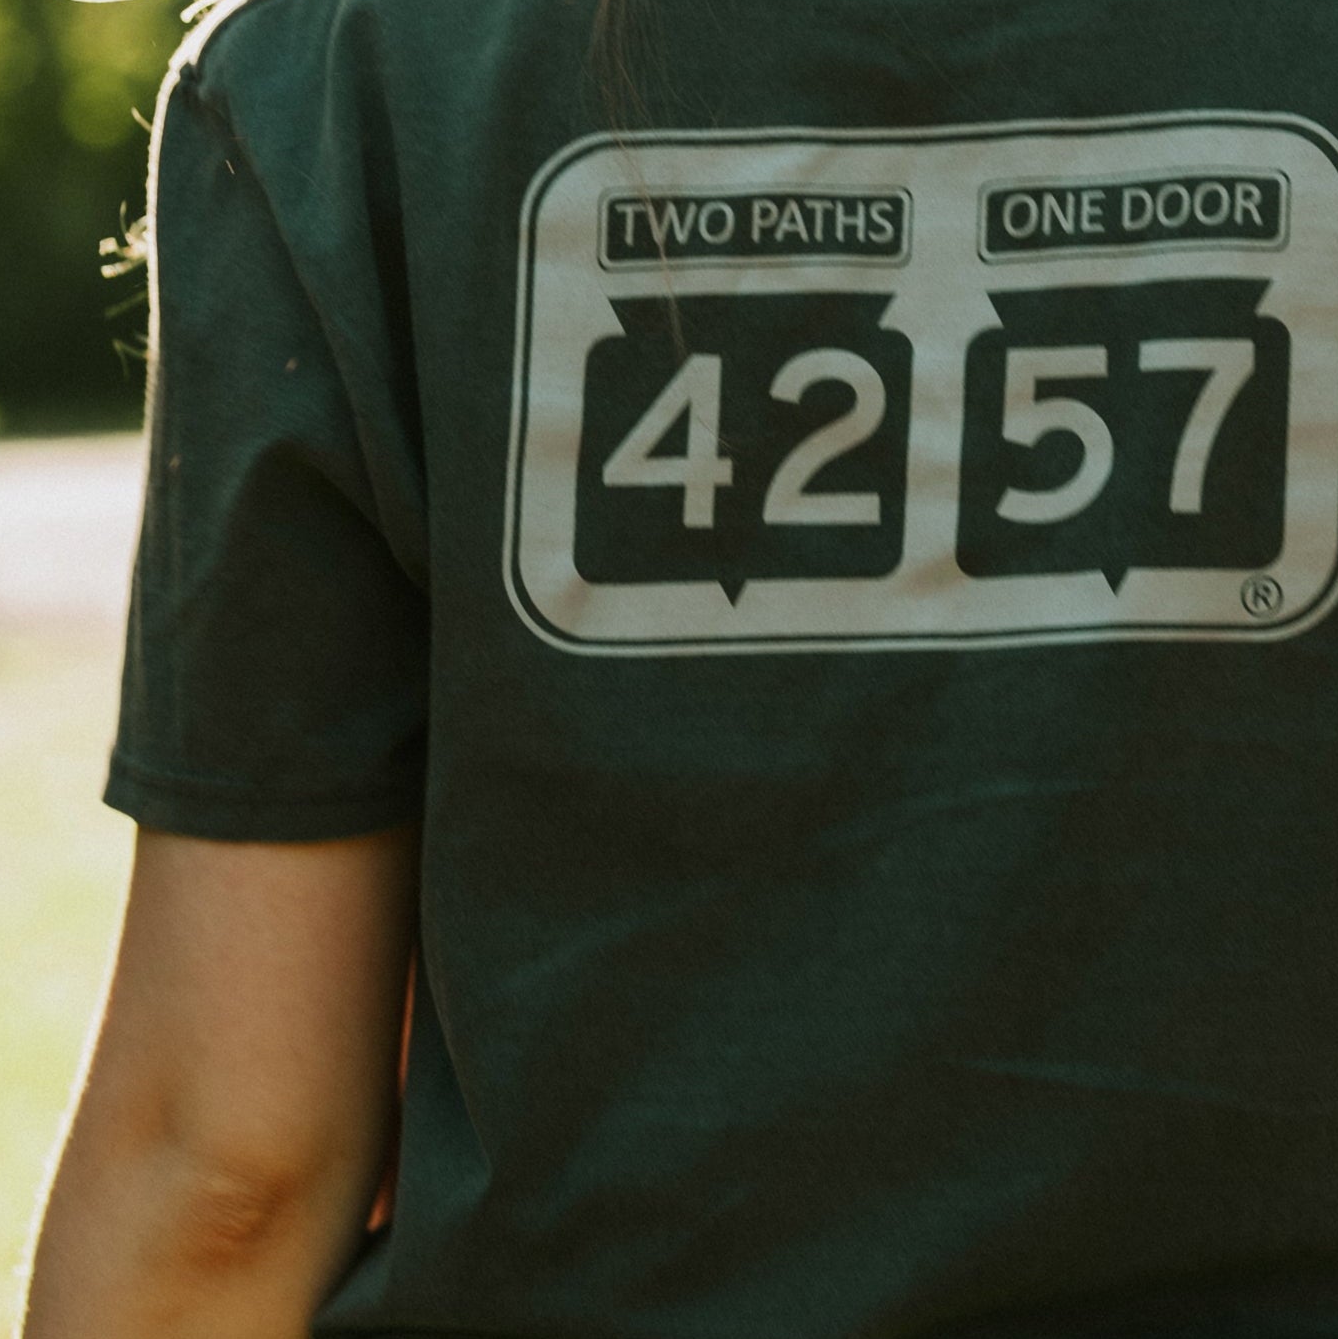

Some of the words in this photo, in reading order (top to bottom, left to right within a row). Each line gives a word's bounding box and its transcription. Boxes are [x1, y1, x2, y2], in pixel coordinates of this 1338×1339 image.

[614, 200, 736, 247] TWO
[750, 198, 896, 245] PATHS
[1002, 189, 1105, 239] ONE
[1121, 181, 1264, 231] DOOR
[601, 347, 888, 529] 42
[995, 338, 1257, 525] 57
